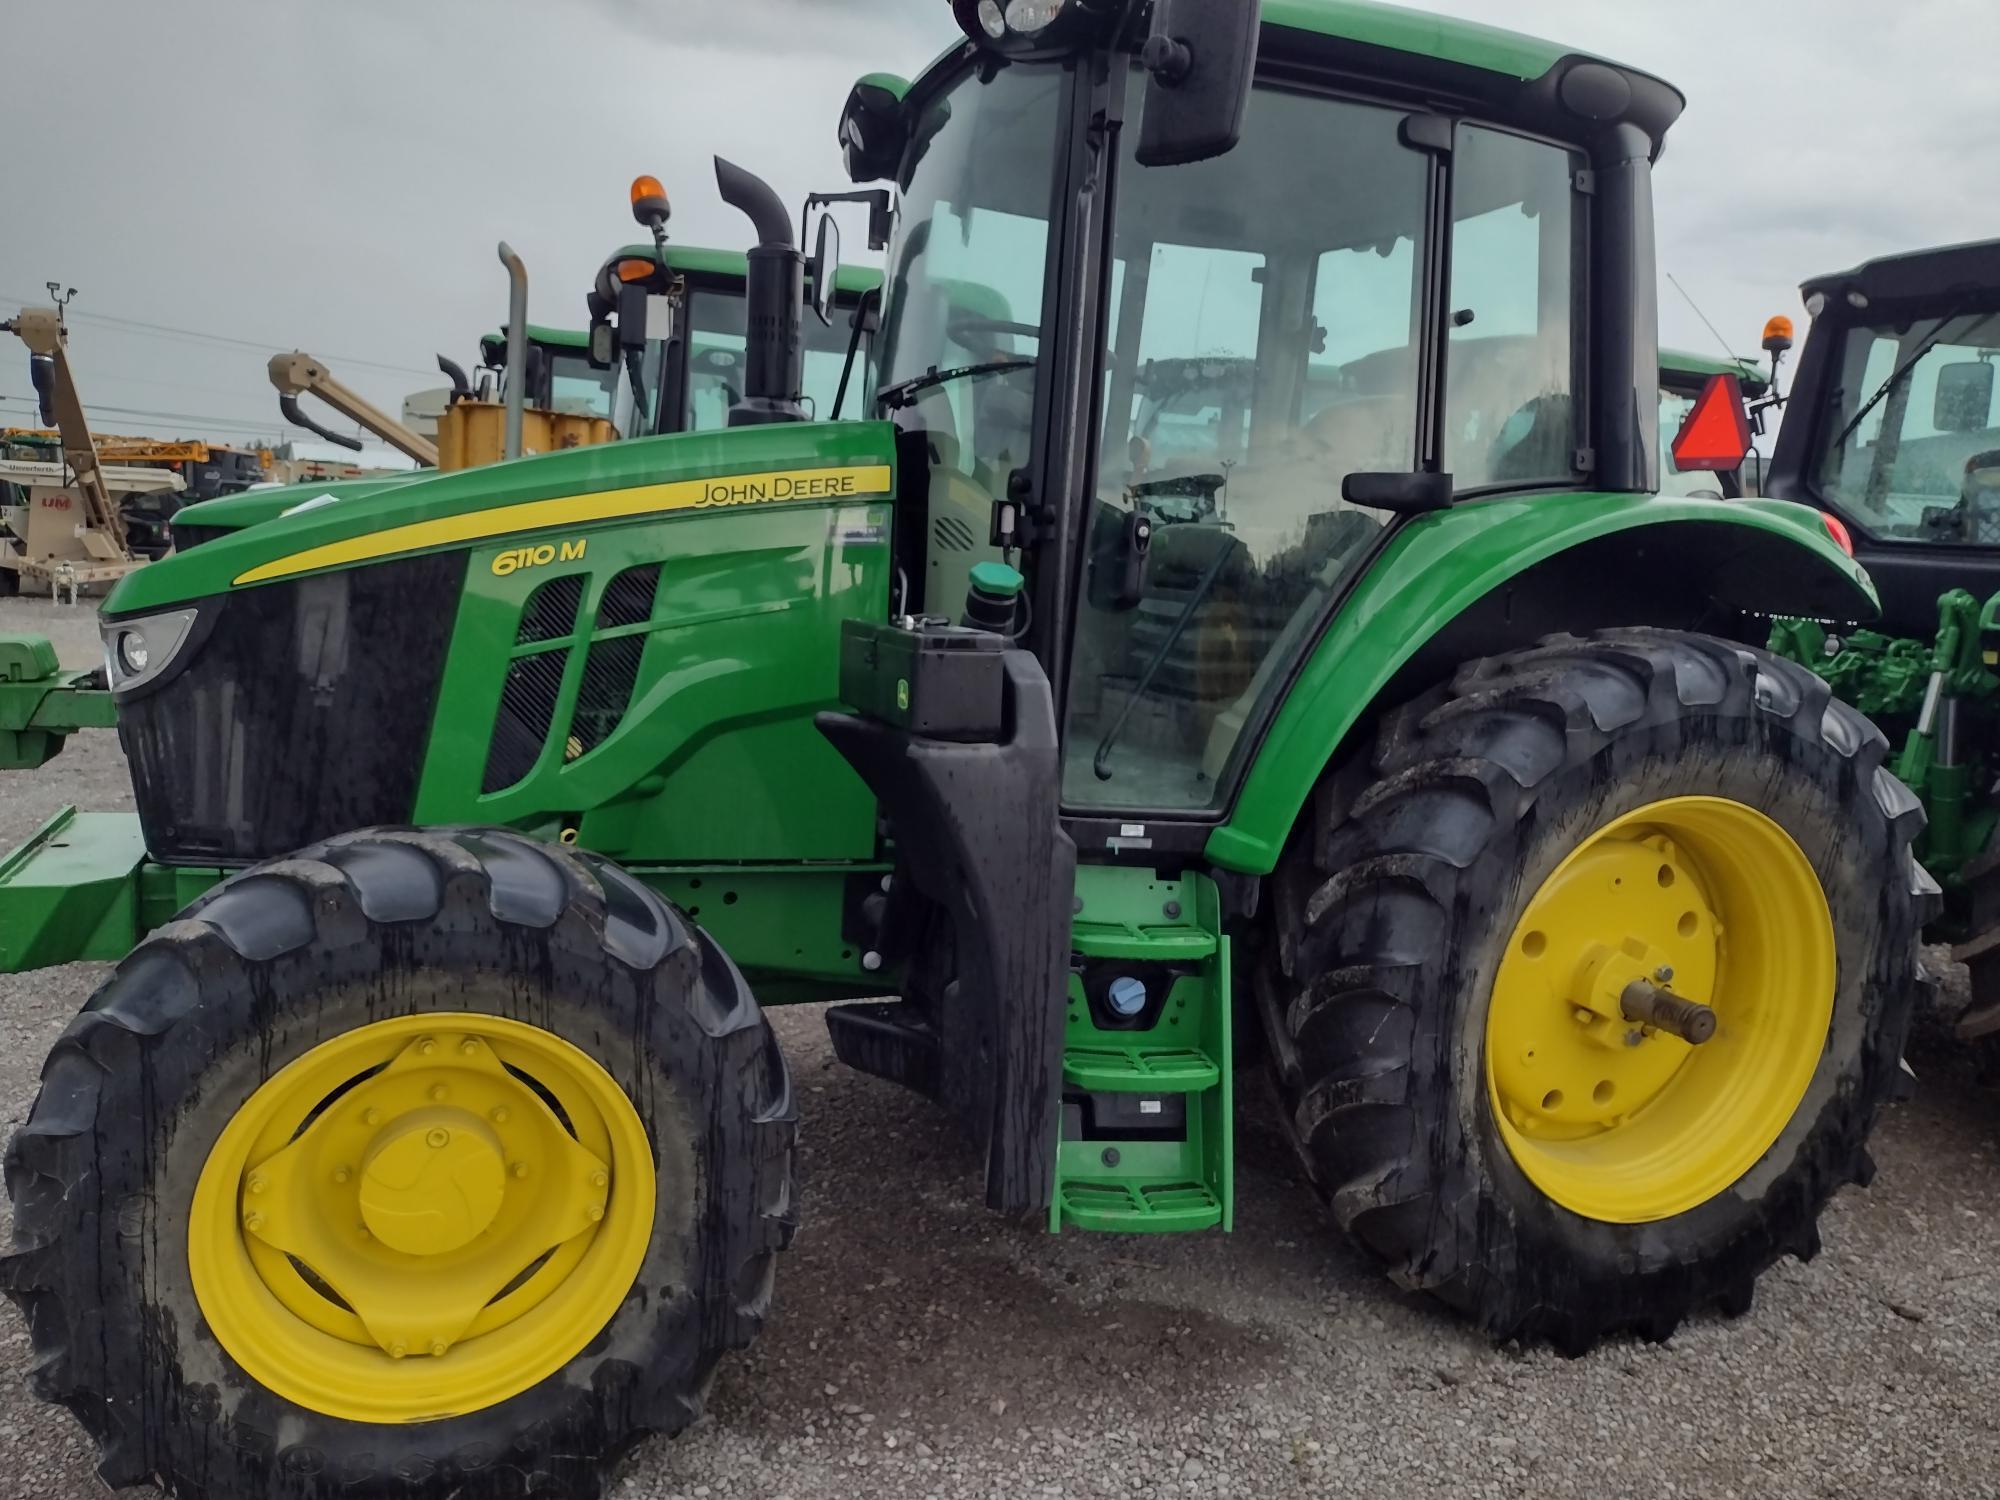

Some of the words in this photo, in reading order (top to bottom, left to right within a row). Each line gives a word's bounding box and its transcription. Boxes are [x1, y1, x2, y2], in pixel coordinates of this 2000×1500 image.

[696, 483, 766, 504] JOHN
[774, 476, 855, 498] DEERE
[491, 544, 556, 576] 6110
[559, 539, 587, 562] M
